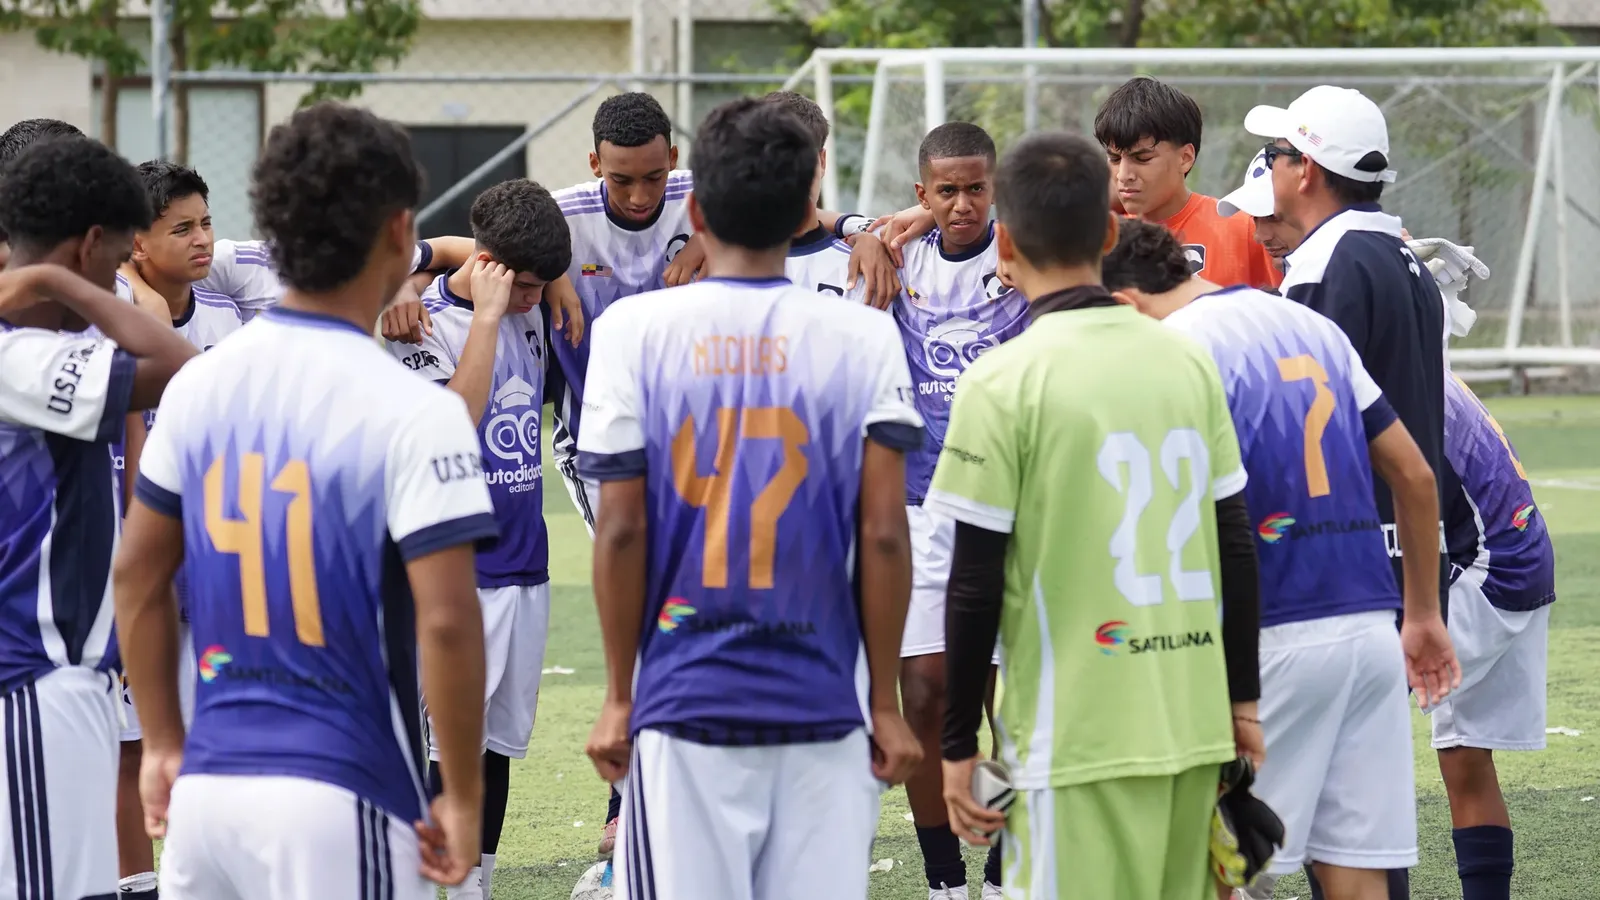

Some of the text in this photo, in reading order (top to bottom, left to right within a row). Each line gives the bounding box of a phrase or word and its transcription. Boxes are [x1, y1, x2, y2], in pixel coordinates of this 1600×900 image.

[671, 407, 809, 589] 47
[1277, 354, 1338, 499] 7
[204, 452, 325, 648] 41
[1097, 428, 1214, 607] 22
